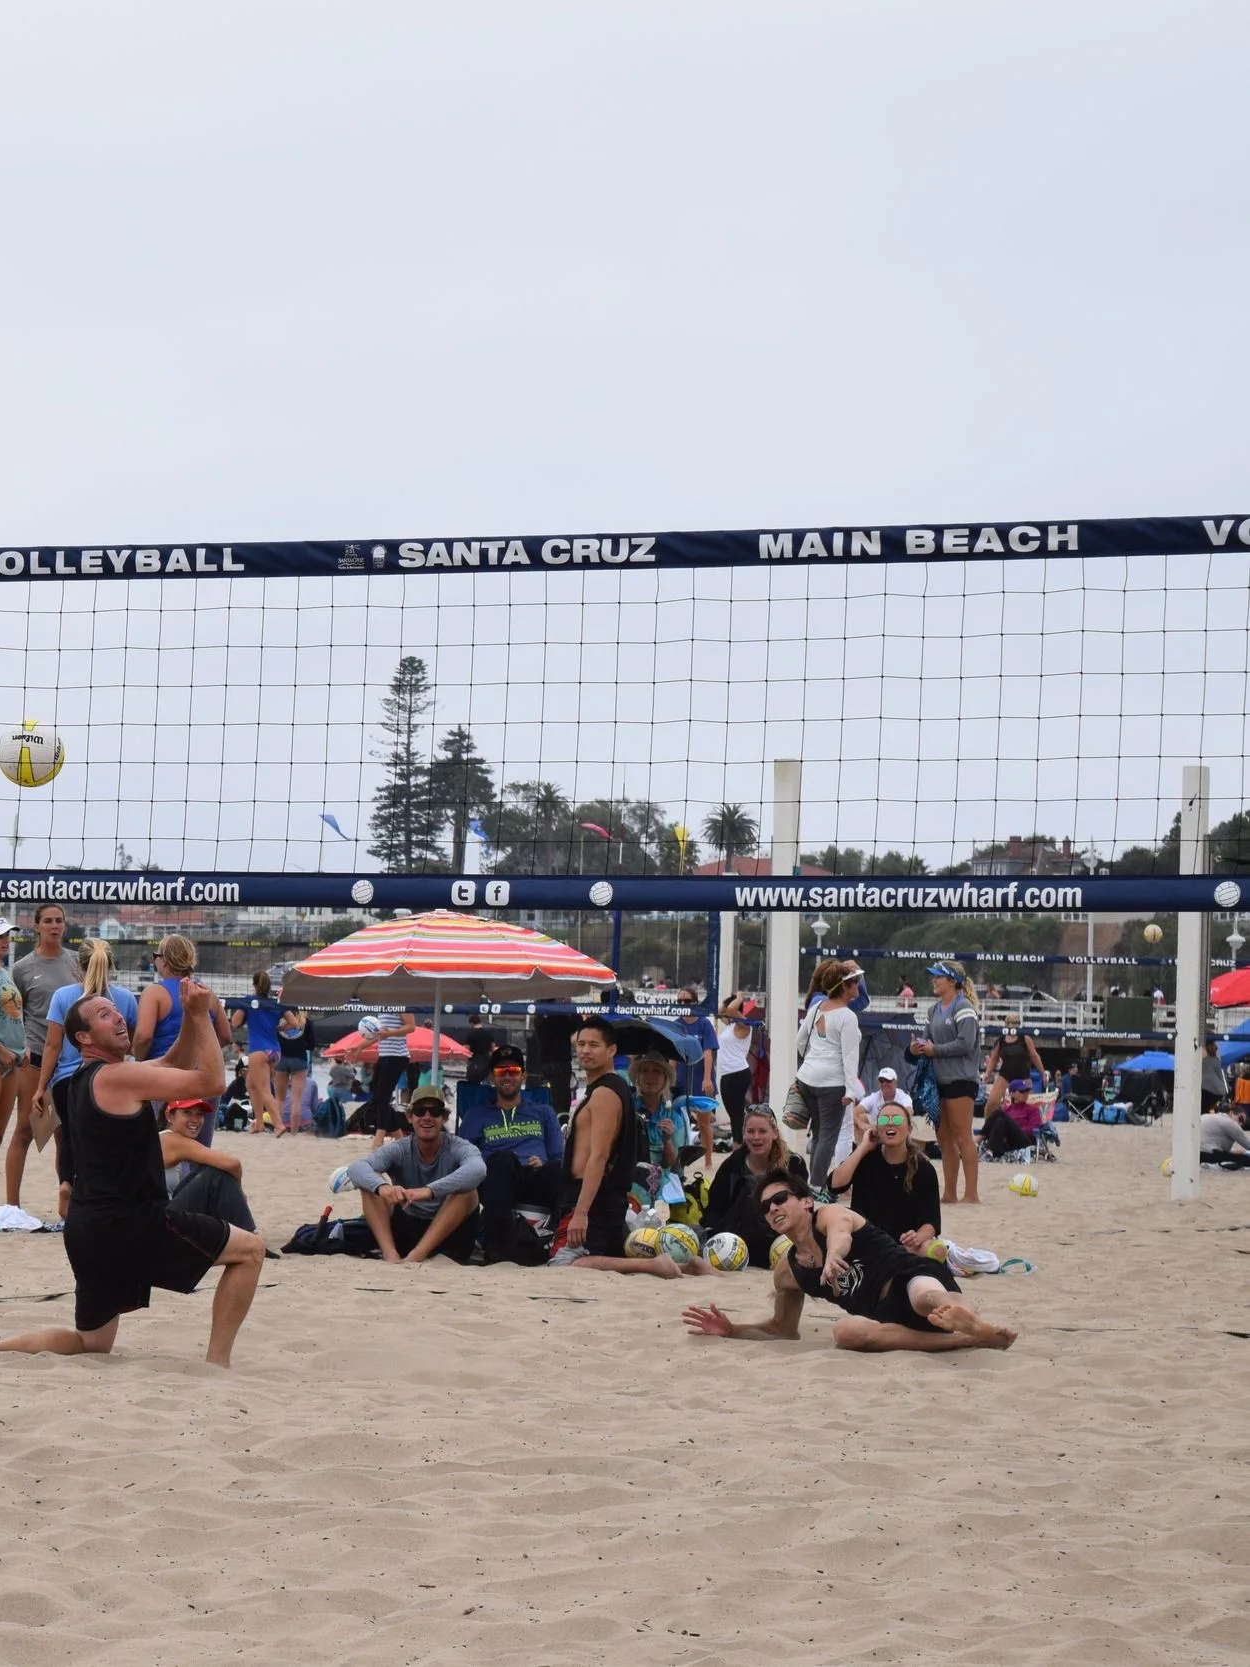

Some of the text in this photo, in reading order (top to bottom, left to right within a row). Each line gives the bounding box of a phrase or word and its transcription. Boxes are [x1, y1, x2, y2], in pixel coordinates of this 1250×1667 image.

[759, 524, 1079, 558] MAIN BEACH
[397, 537, 656, 568] SANTA CRUZ
[12, 734, 44, 745] Wilson
[735, 881, 1082, 908] www.santacruzwharf.com
[897, 951, 955, 960] SANTA CRUZ
[976, 953, 1045, 962] MAIN BEACH
[1068, 956, 1139, 965] VOLLEYBALL
[576, 1005, 691, 1016] www.satacruzwharf.com
